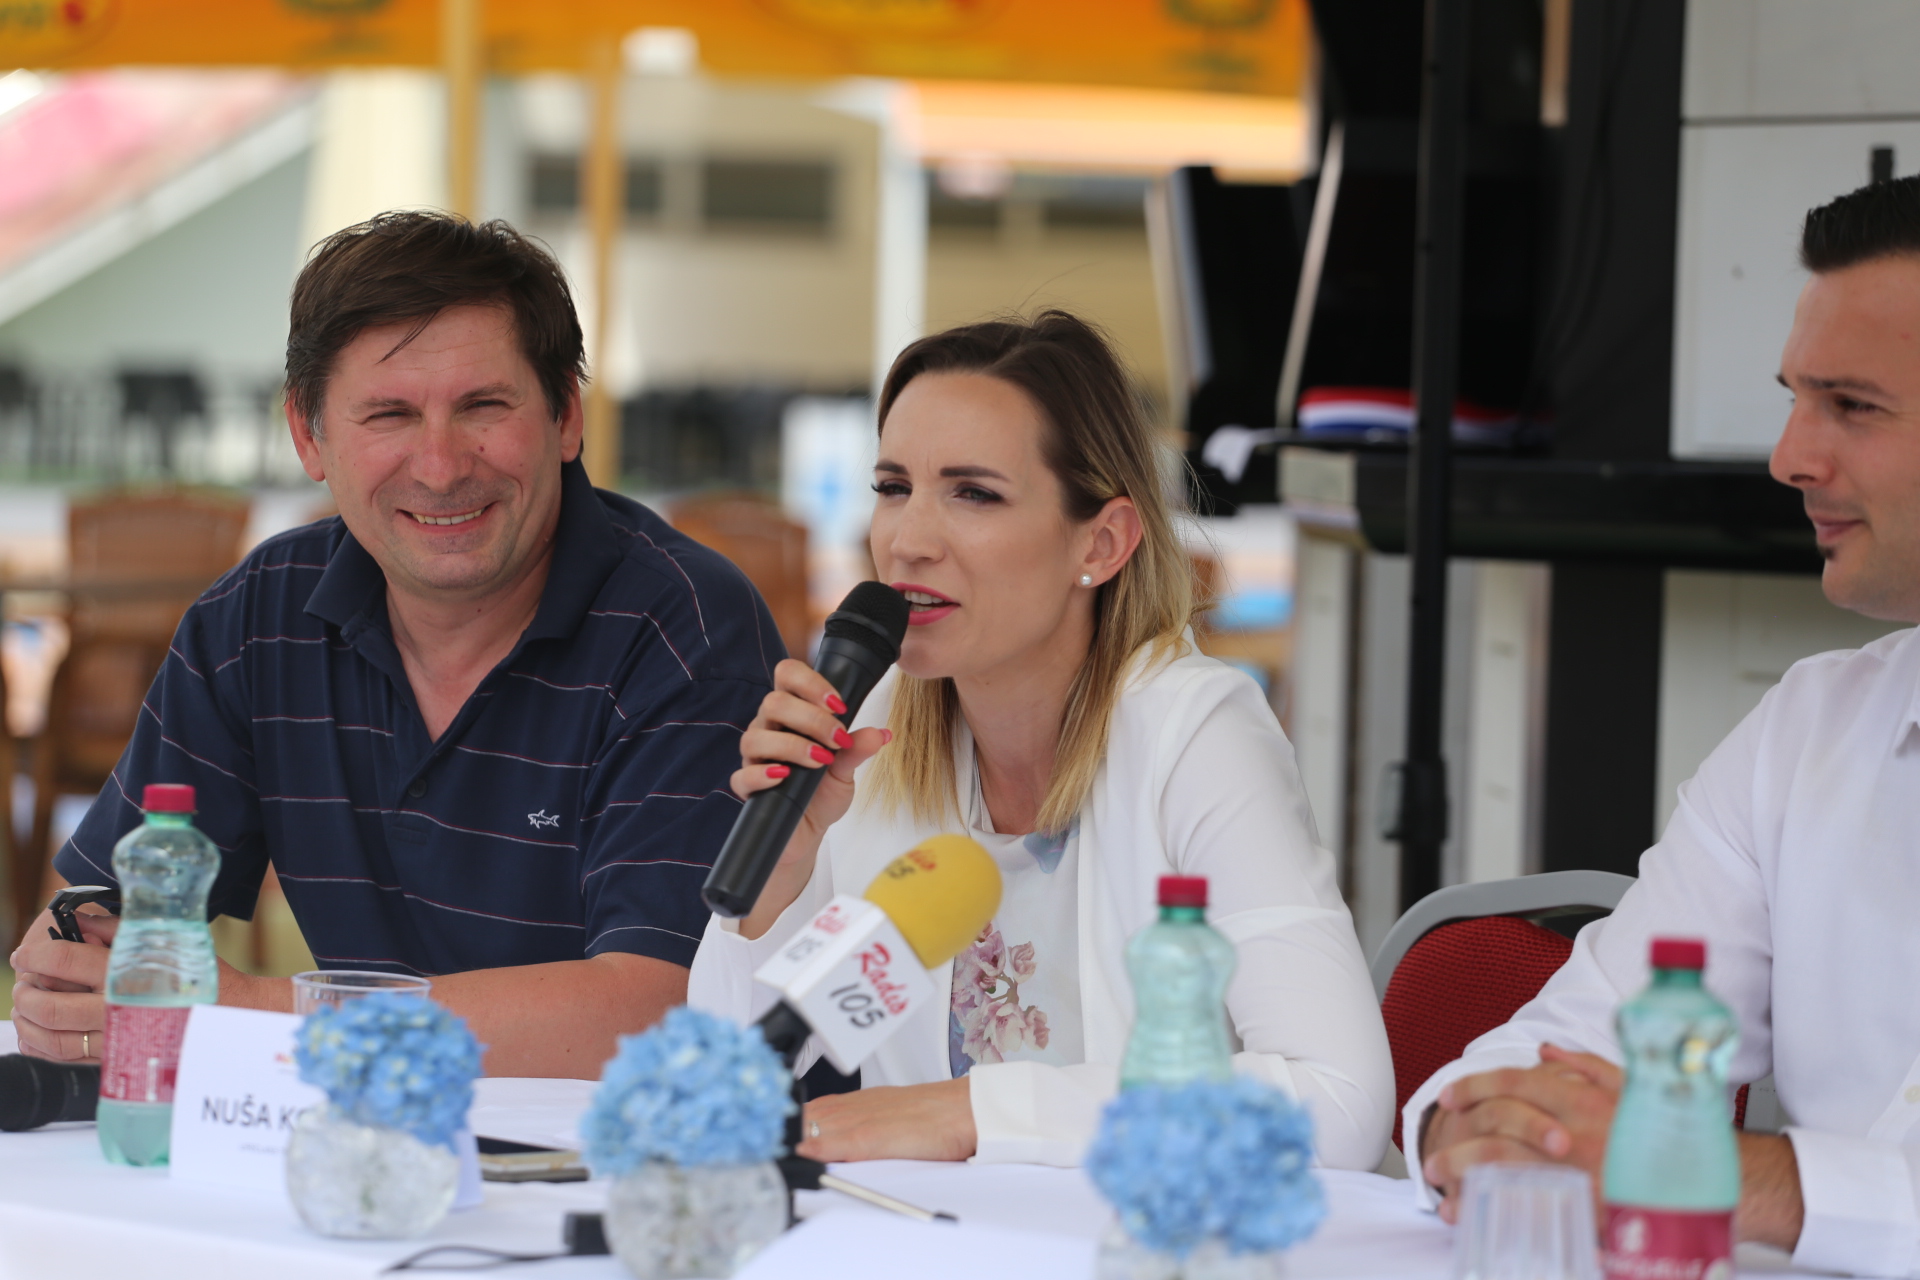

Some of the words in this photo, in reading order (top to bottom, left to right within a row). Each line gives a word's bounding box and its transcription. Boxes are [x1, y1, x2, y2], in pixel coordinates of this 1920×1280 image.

[852, 941, 910, 1015] Radio
[828, 980, 886, 1029] 105
[201, 1093, 272, 1129] NUŠA
